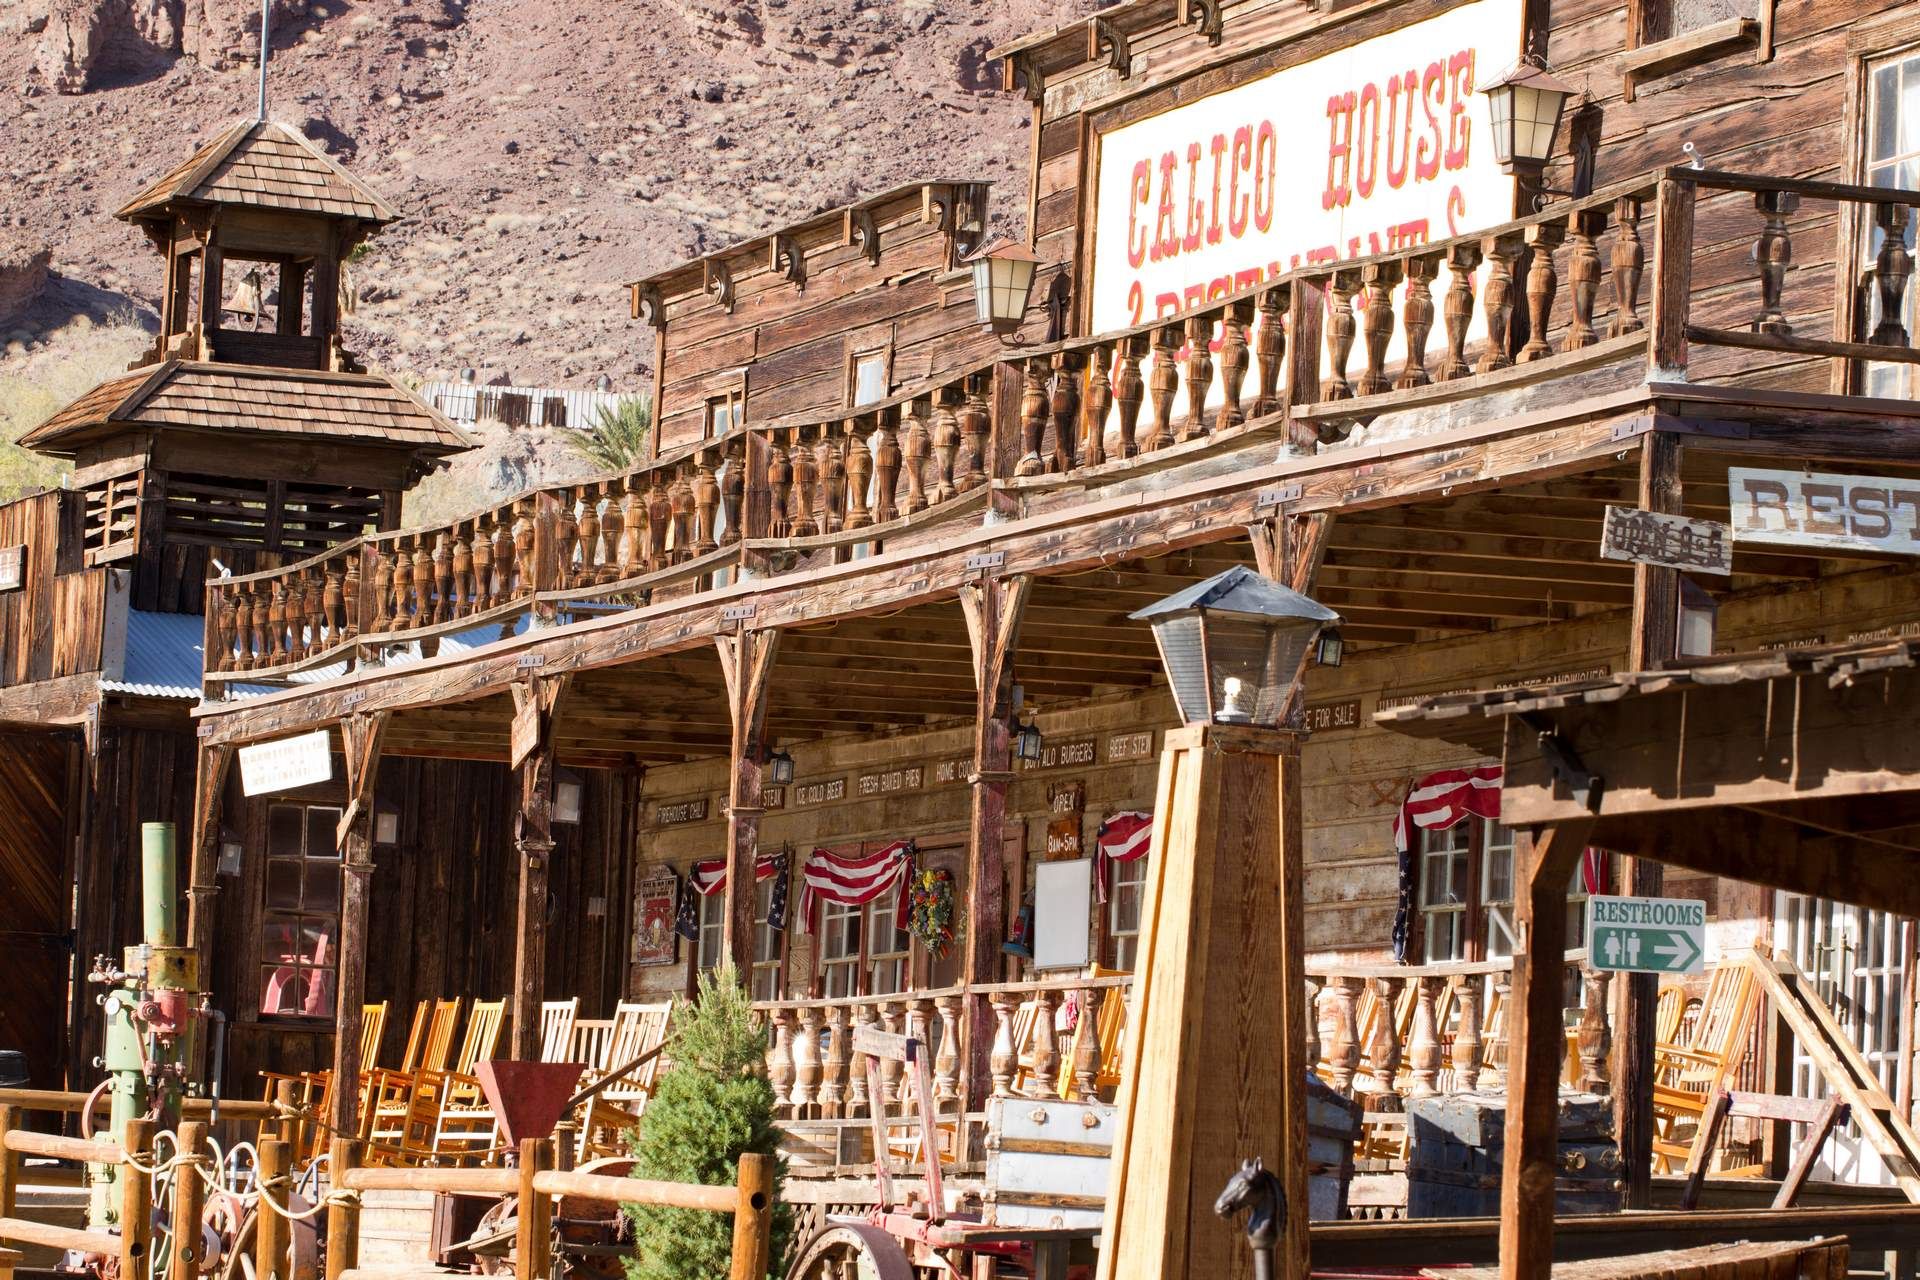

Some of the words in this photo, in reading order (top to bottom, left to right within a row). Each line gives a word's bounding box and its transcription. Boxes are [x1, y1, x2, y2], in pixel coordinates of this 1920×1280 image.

[1127, 119, 1277, 269] CALICO
[1322, 48, 1475, 211] HOUSE
[1315, 707, 1330, 728] FOR
[1334, 704, 1355, 725] SALE
[1061, 742, 1094, 765] BURGERS
[1109, 737, 1129, 758] BEEF
[1132, 735, 1152, 755] STEW
[858, 776, 879, 796] FRESH
[881, 771, 903, 793] BAKED
[905, 767, 921, 789] PIES
[936, 762, 955, 783] HOME
[762, 788, 783, 807] STEAK
[796, 786, 806, 805] ICE
[808, 783, 824, 803] COLD
[826, 779, 845, 800] BEER
[1053, 792, 1075, 814] OPEN
[1593, 901, 1703, 927] RESTROOMS
